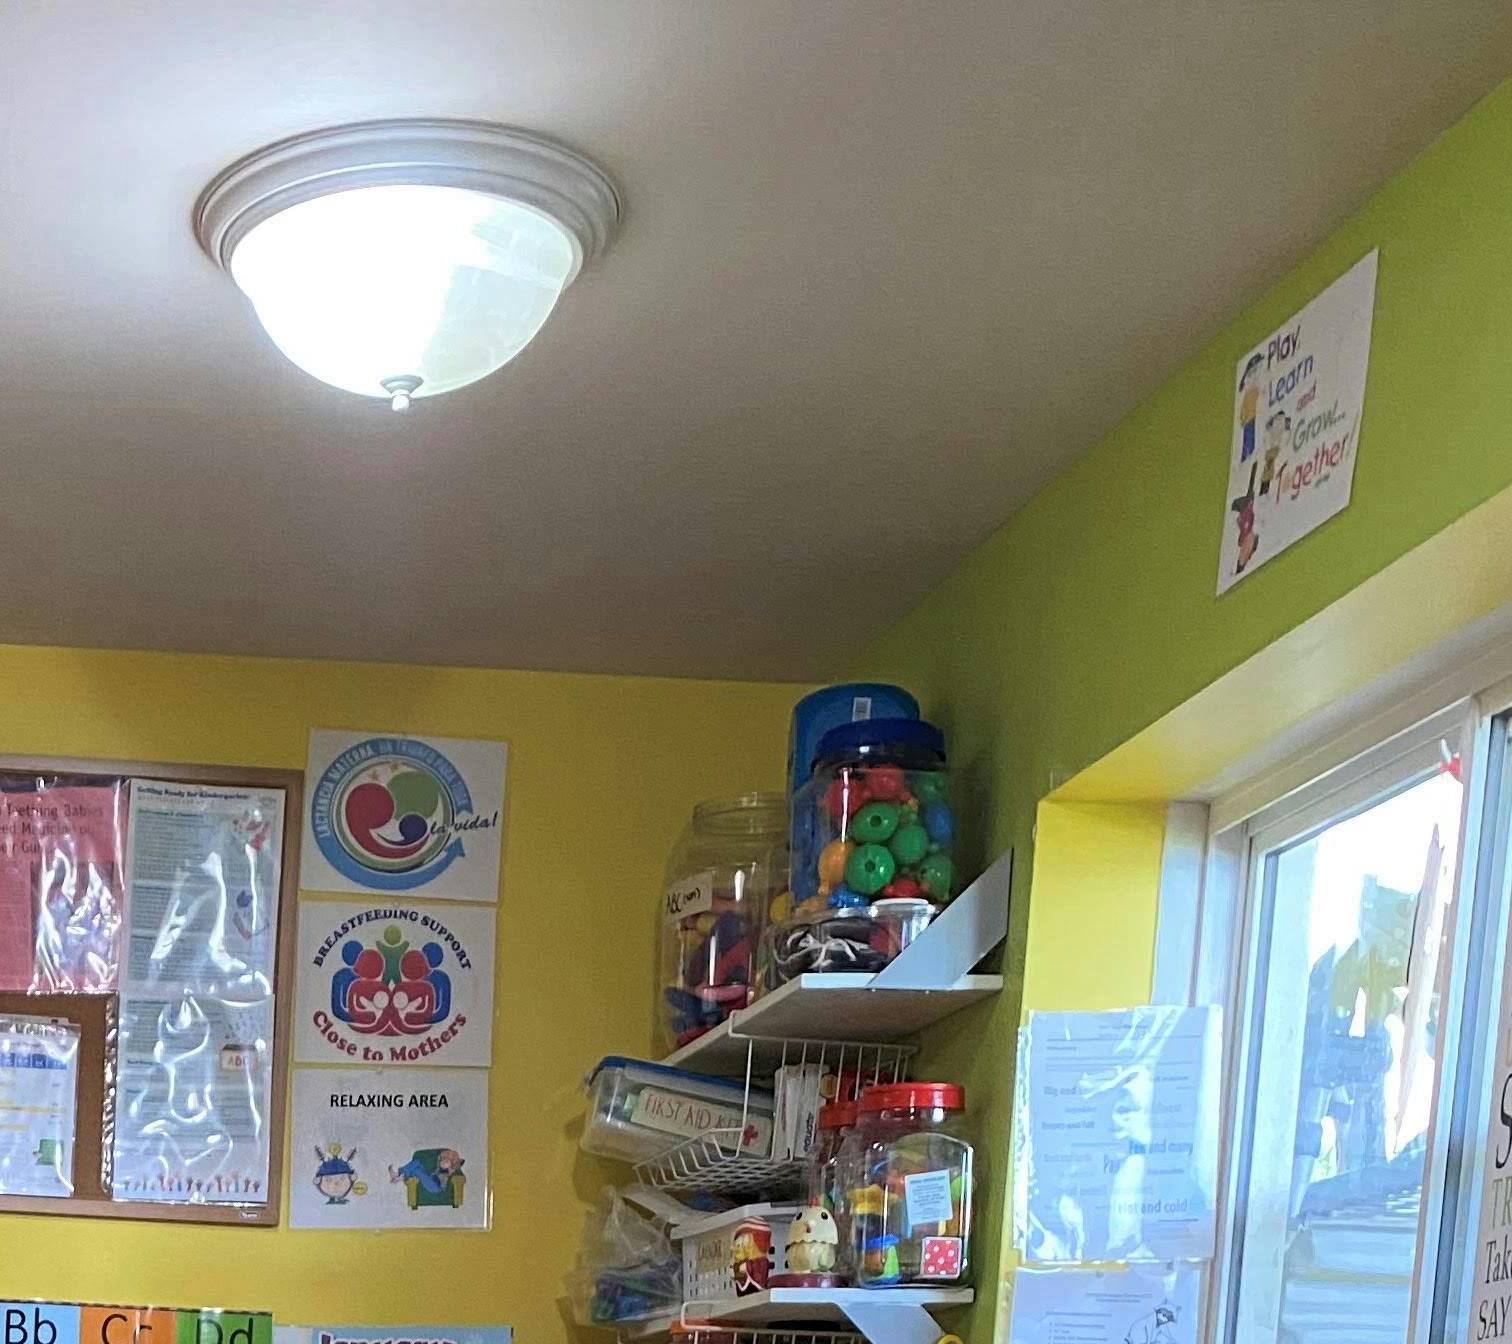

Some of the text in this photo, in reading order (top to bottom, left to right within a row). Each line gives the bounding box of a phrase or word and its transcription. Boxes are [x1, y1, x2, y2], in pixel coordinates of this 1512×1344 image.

[1268, 355, 1314, 407] Learn
[1296, 379, 1317, 412] and
[430, 811, 499, 834] la vida!
[313, 909, 472, 970] BREASTFEEDING SUPPORT
[313, 1011, 467, 1062] Close to Mothers
[330, 1095, 448, 1108] RELAXING AREA
[644, 1094, 711, 1129] FIRST AID
[1141, 1200, 1161, 1213] and
[1477, 1294, 1512, 1341] SAY
